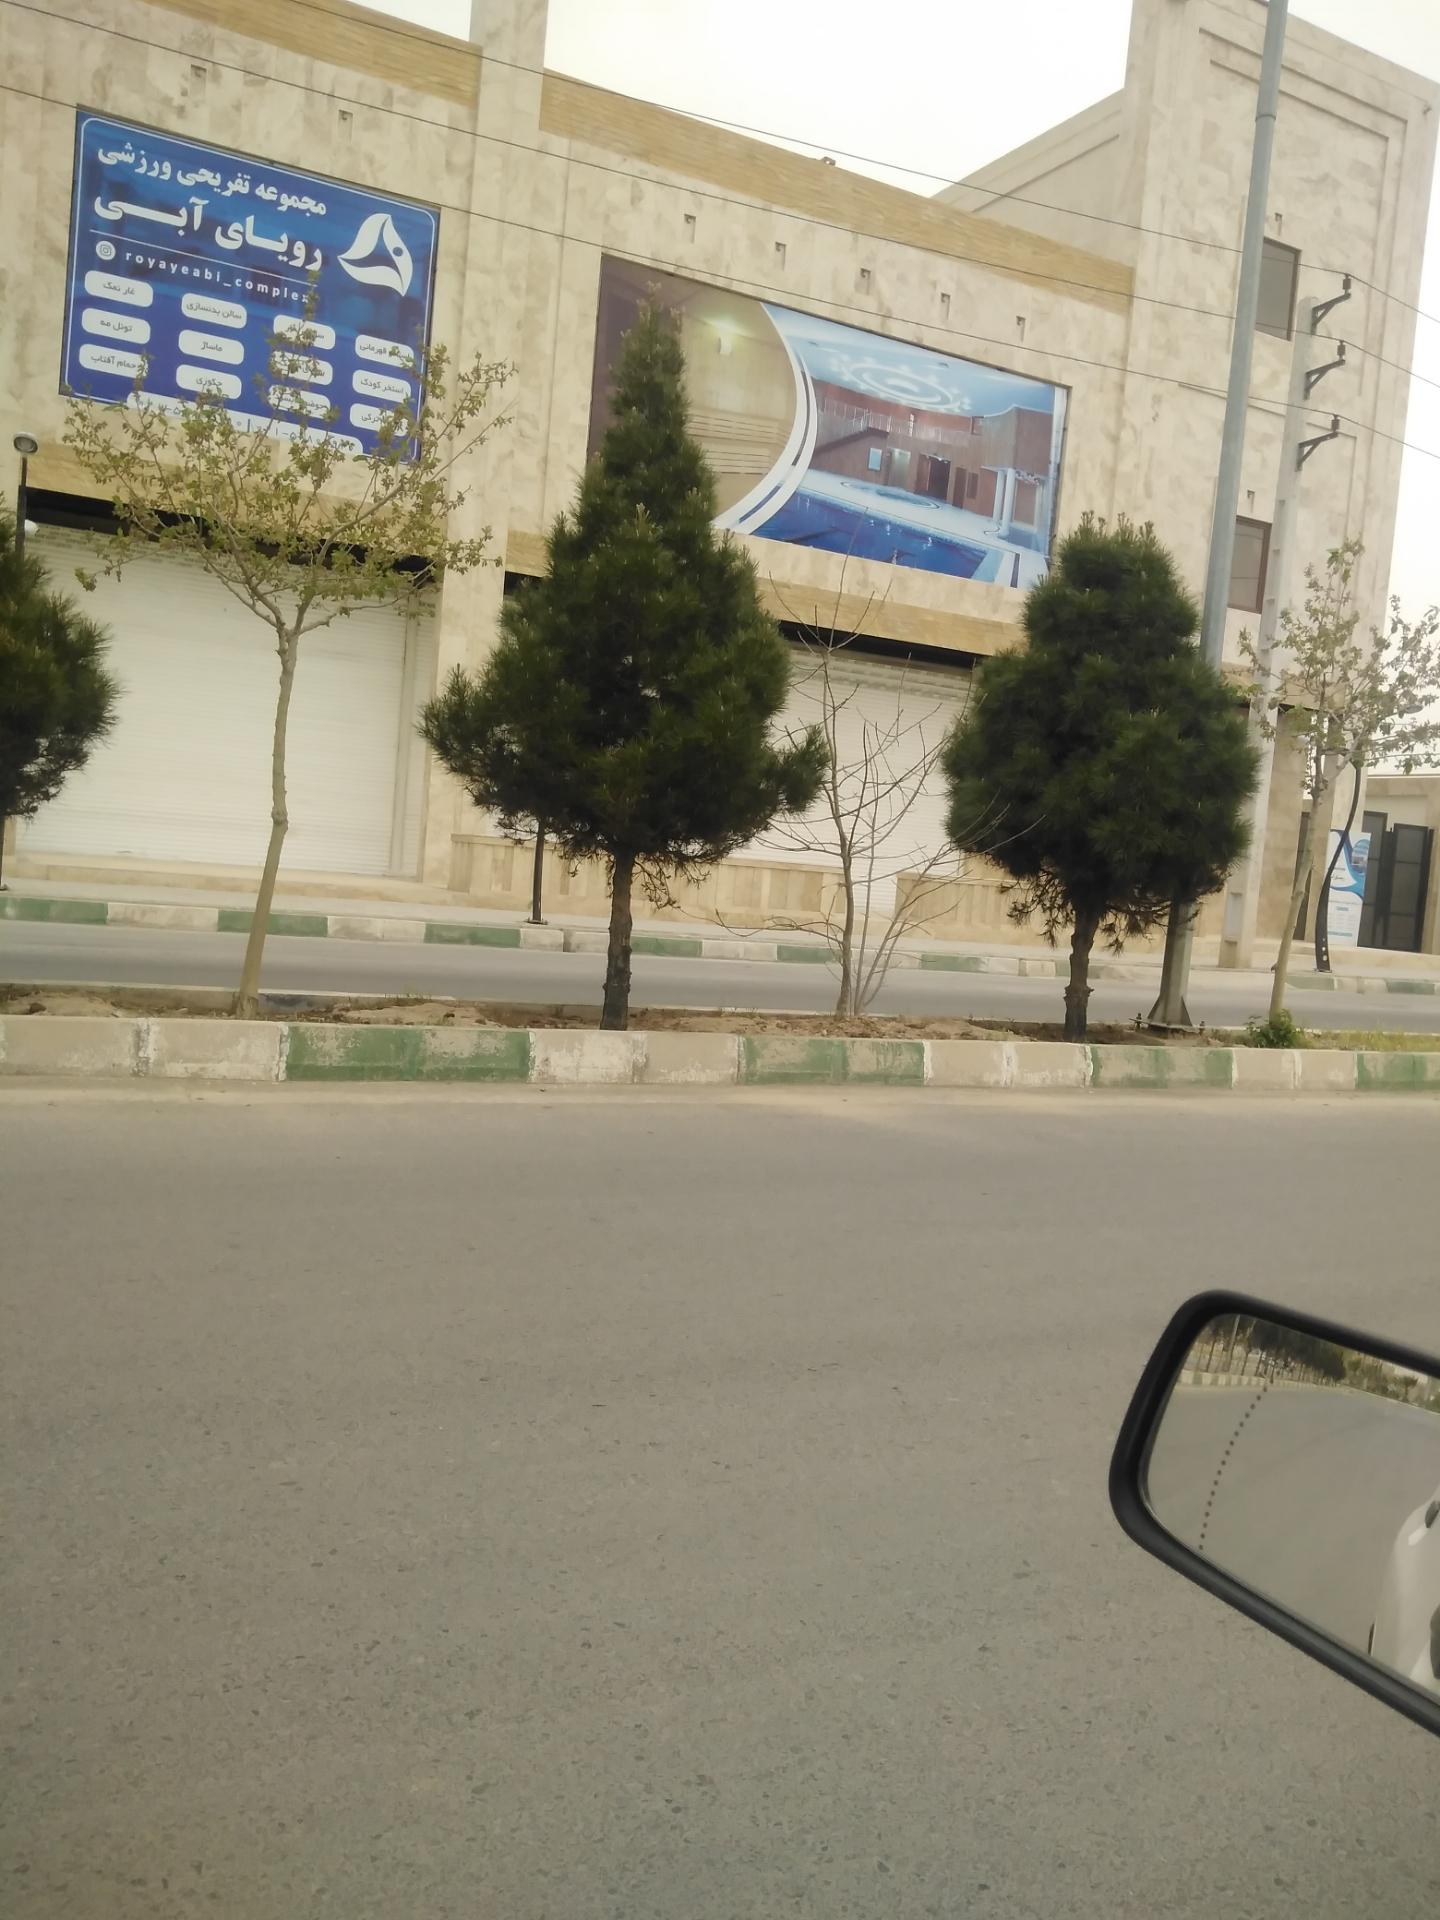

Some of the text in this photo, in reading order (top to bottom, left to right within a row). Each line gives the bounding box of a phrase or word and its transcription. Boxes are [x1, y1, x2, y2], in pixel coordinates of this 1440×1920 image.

[98, 142, 327, 217] مجموعه تفریحی ورزشی
[94, 196, 323, 272] رویای آبی
[125, 250, 310, 304] royayeabi_complex
[102, 281, 136, 296] غار نمک
[186, 302, 242, 319] سالن بدنسازی
[112, 321, 133, 333] تونل
[201, 341, 223, 351] ماساژ
[360, 378, 404, 393] استخر کودک
